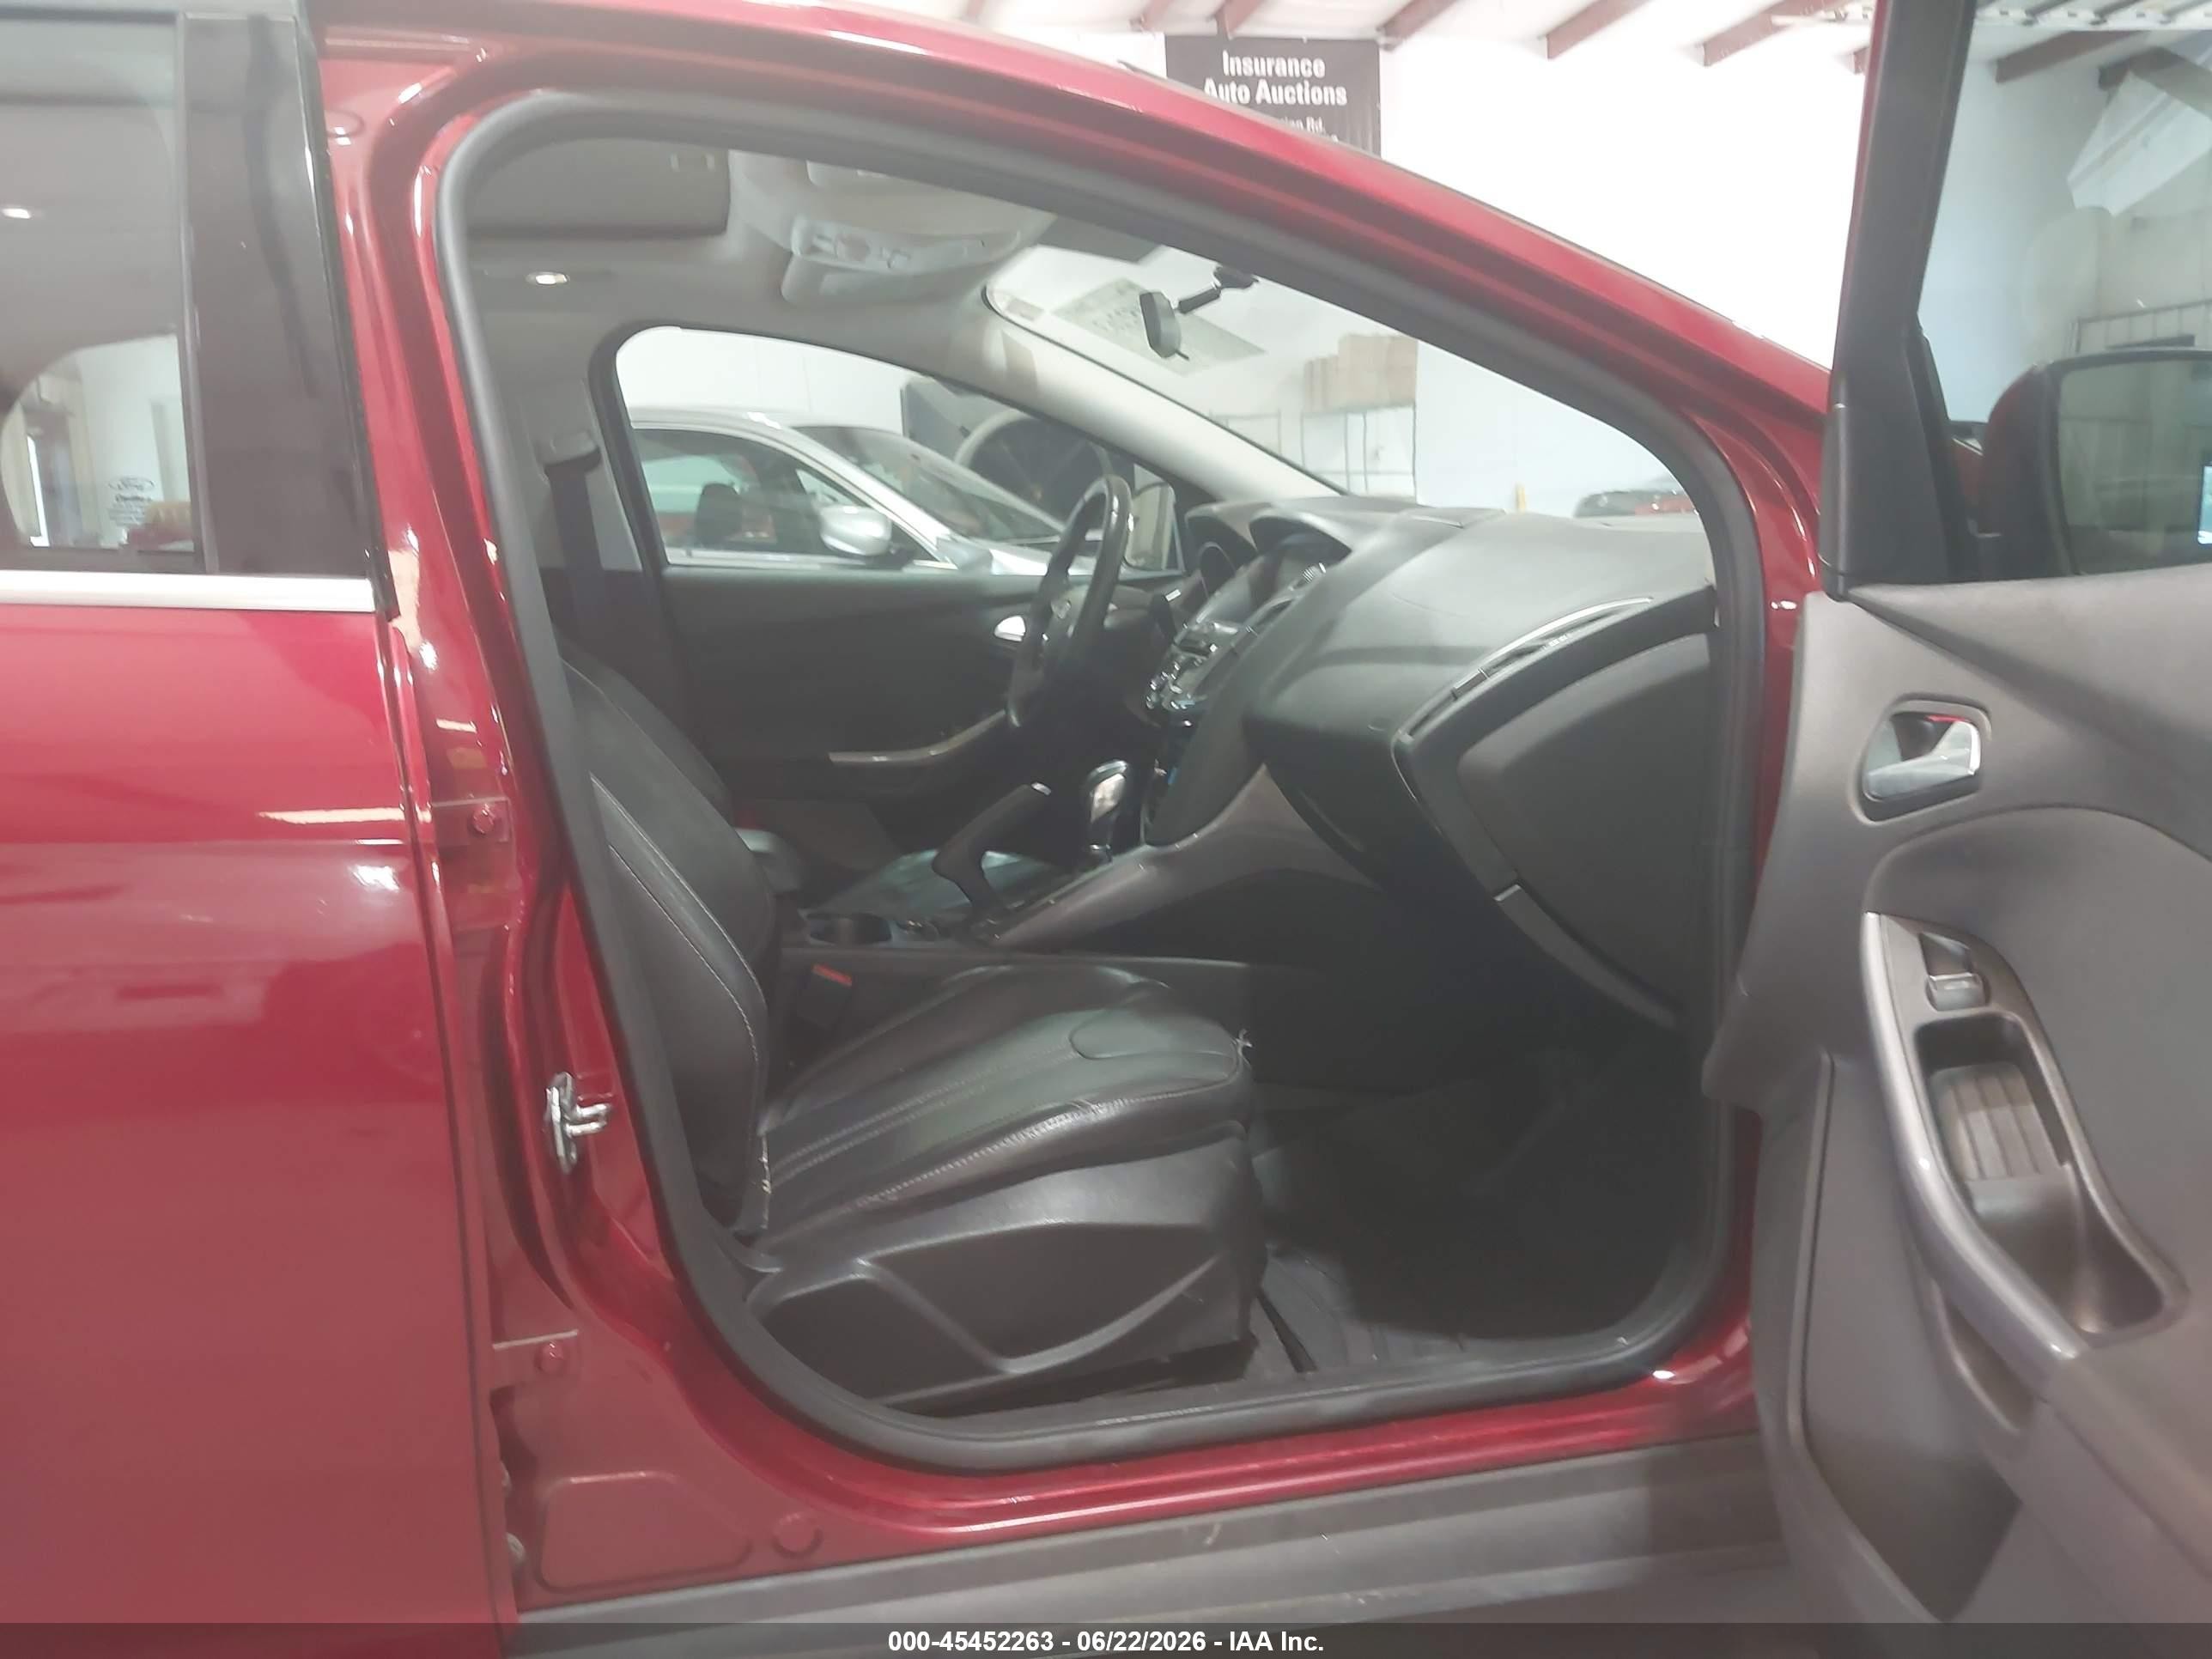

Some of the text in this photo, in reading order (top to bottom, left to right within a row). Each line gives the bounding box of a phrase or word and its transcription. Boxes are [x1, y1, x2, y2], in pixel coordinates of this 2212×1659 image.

[1223, 50, 1325, 78] Insurance
[1204, 78, 1347, 106] Auto Auctions
